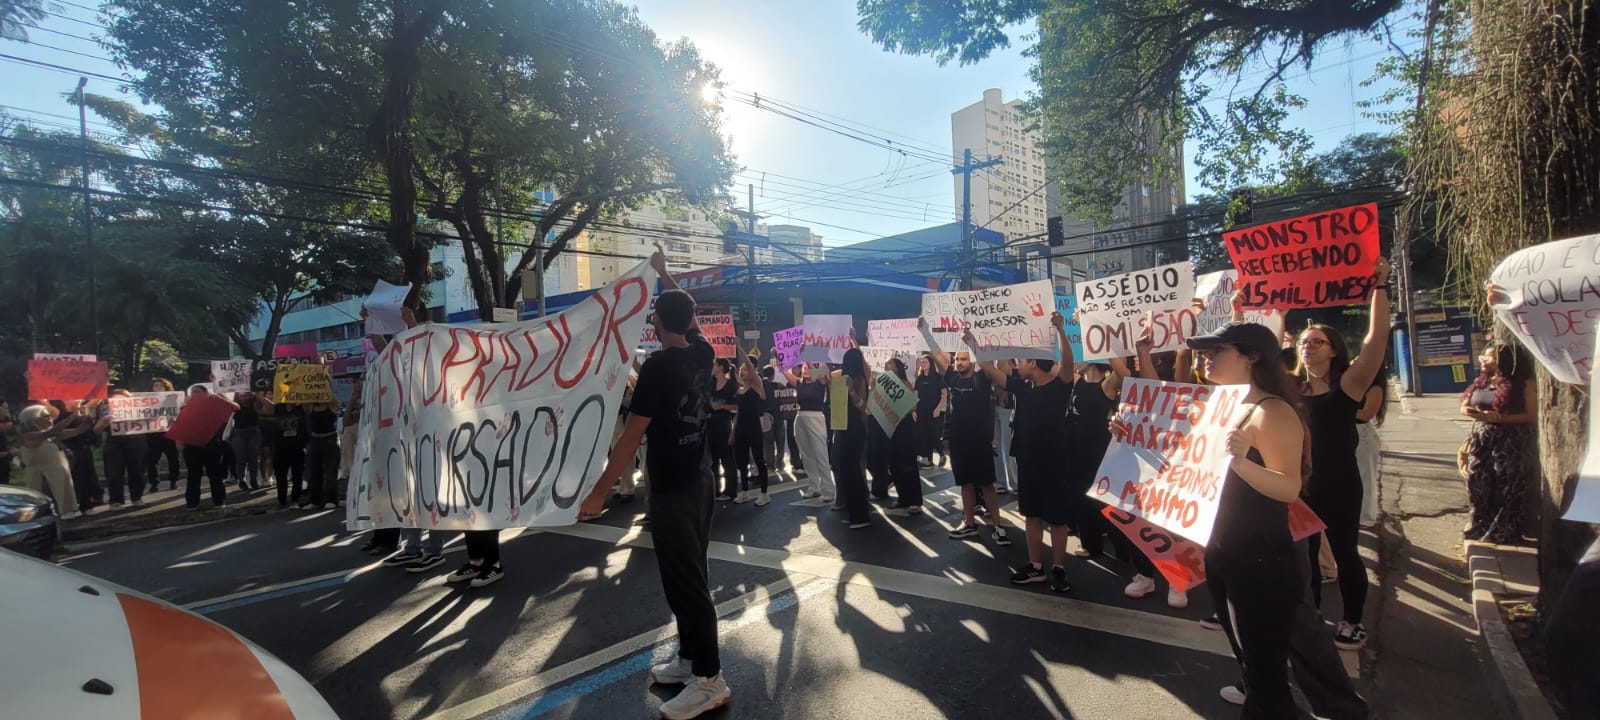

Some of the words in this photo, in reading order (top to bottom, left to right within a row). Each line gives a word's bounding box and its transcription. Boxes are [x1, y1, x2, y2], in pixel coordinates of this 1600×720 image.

[1231, 207, 1374, 254] MONSTRO
[1239, 242, 1361, 276] RECEBENDO
[1082, 267, 1179, 302] ASSÉDIO
[1314, 276, 1379, 301] UNESP
[958, 296, 967, 306] O
[963, 303, 1010, 317] PROTEGE
[1055, 298, 1071, 310] AR
[1080, 302, 1099, 315] NÃO
[1104, 300, 1116, 311] SE
[1121, 292, 1178, 308] RESOLVE
[974, 315, 1028, 329] AGRESSOR
[804, 330, 851, 350] MÁXIMO
[1020, 326, 1057, 347] CALE
[378, 275, 649, 429] ESTUPRADOR
[256, 358, 310, 371] ASSDIO
[877, 374, 905, 402] UNESP
[111, 397, 160, 408] UNESP
[113, 409, 133, 419] SEM
[1120, 382, 1210, 426] ANTES
[1210, 389, 1240, 427] DO
[1116, 416, 1208, 464] MÁXIMO
[1156, 461, 1222, 502] PEDIMOS
[1095, 475, 1111, 496] O
[1119, 477, 1200, 529] MÍNIMO
